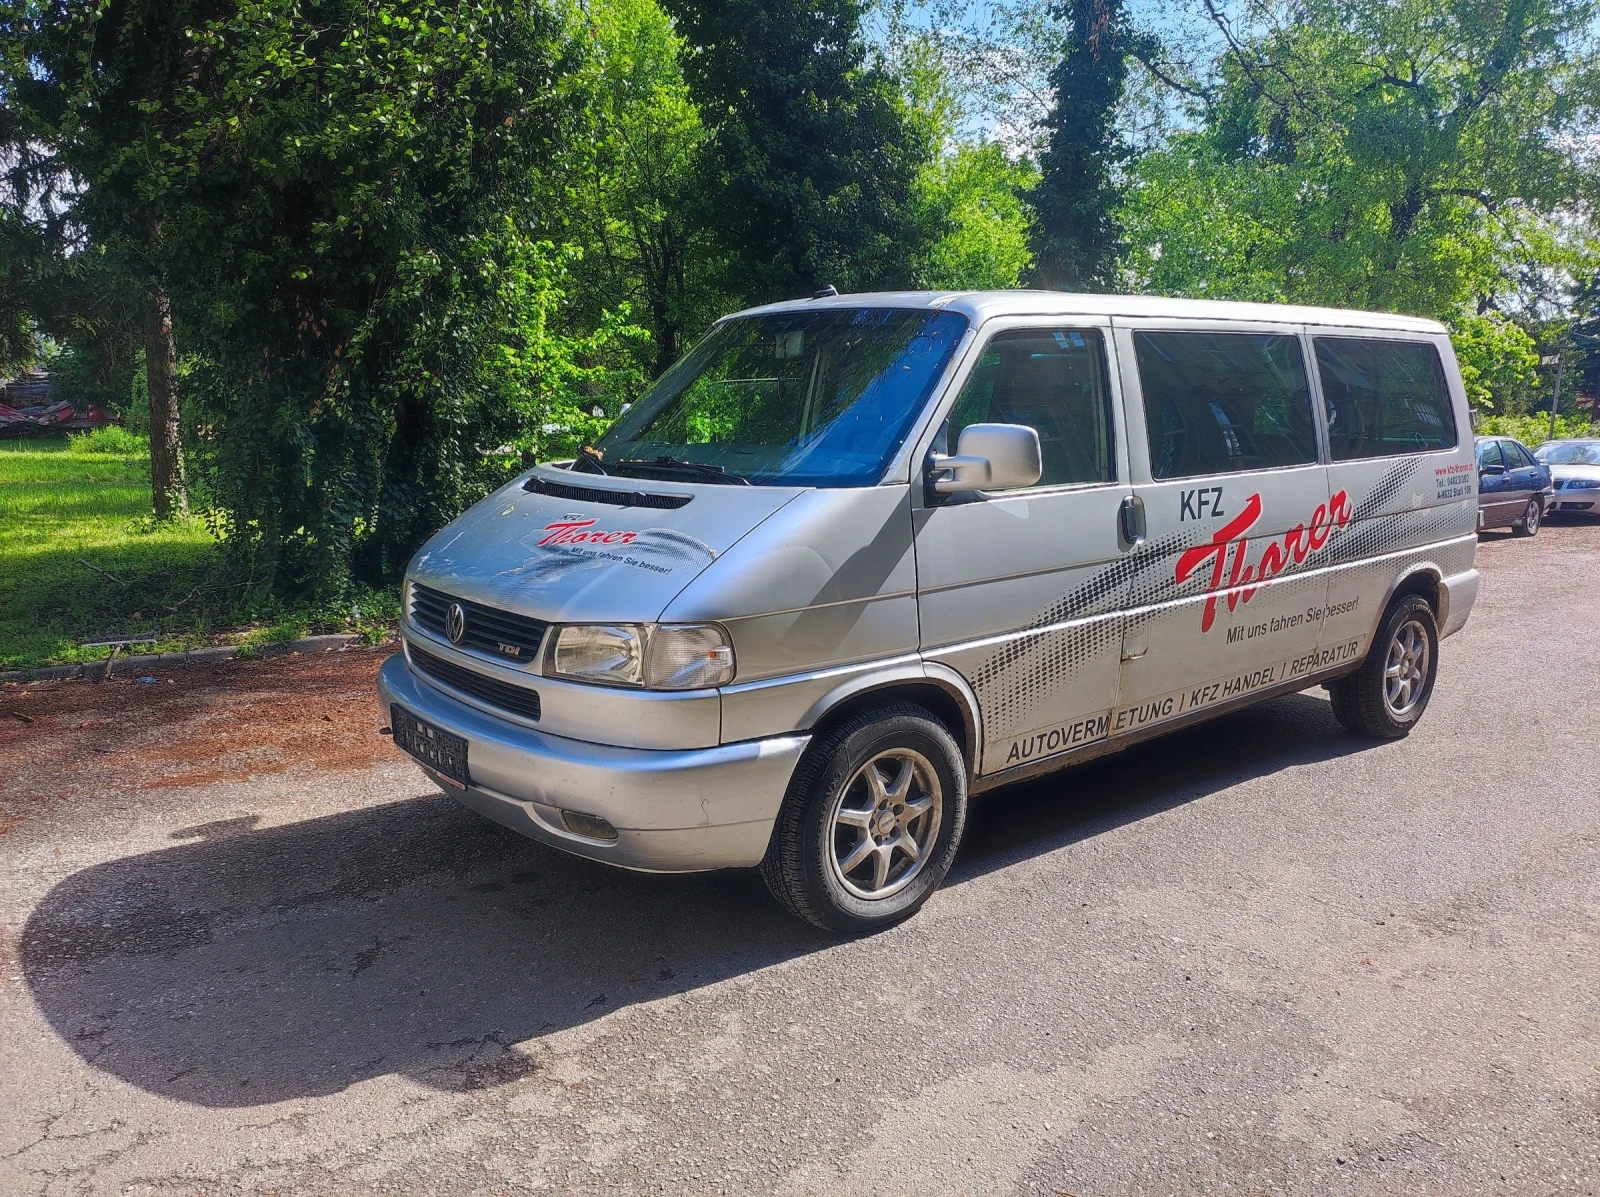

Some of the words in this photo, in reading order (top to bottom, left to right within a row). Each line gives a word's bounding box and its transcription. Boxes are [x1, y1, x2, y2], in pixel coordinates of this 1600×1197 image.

[1180, 486, 1225, 522] KFZ
[538, 519, 638, 547] Thorer
[569, 546, 581, 555] Mit
[582, 549, 597, 558] uns
[597, 551, 623, 563] fahren
[623, 556, 639, 567] Sie
[639, 560, 673, 576] besser!
[1175, 489, 1352, 633] Thorer
[1226, 625, 1246, 645] Mit
[1247, 623, 1267, 639] uns
[1269, 614, 1303, 633] fahren
[1305, 607, 1321, 623] Sie
[1322, 595, 1360, 621] besser!
[497, 642, 521, 656] TDI
[1006, 697, 1173, 764] AUTOVERMETUNG
[1189, 683, 1220, 707] KFZ
[1222, 667, 1275, 697] HANDEL
[1289, 641, 1358, 676] REPARATUR
